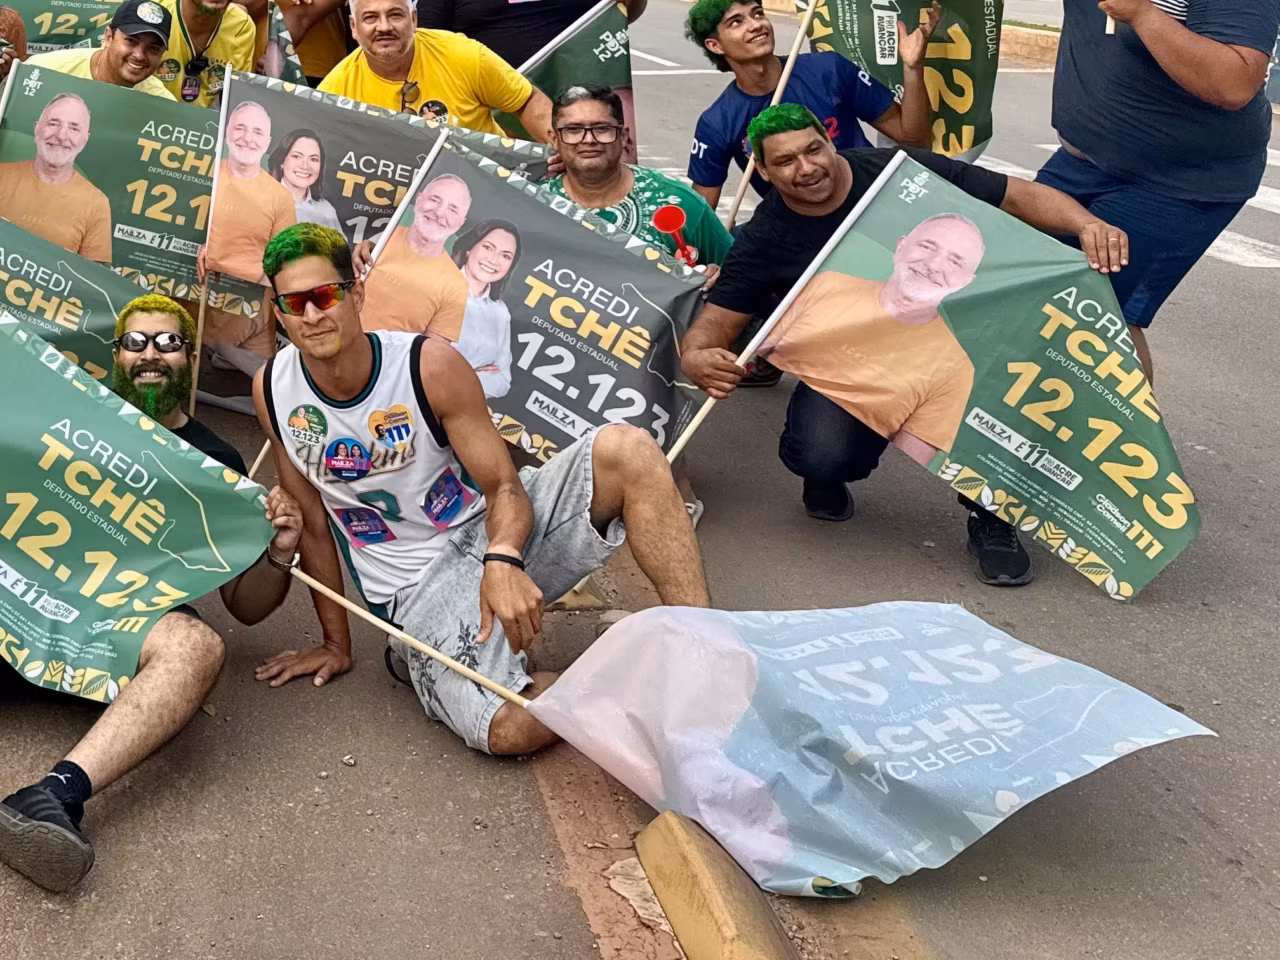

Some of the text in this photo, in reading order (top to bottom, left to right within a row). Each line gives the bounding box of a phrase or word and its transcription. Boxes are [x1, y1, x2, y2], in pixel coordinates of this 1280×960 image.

[51, 0, 82, 8] DEPUTADO
[877, 16, 886, 59] AVANÇAR
[984, 0, 998, 58] ESTADUAL
[593, 43, 611, 62] 12
[599, 31, 627, 57] PDT
[887, 30, 895, 59] ACRE
[23, 80, 43, 89] PDT
[24, 88, 36, 96] 12
[148, 166, 182, 180] DEPUTADO
[898, 189, 915, 204] 12
[900, 178, 929, 199] PDT
[354, 203, 394, 214] DEPUTADO
[117, 227, 174, 250] MAILZA 11
[182, 242, 198, 250] ACRE
[532, 258, 640, 322] ACREDI
[27, 315, 62, 335] ESTADUAL
[525, 275, 652, 370] TCHÊ
[531, 315, 619, 372] DEPUTADO ESTADUAL
[517, 331, 670, 446] 12.123
[1045, 347, 1136, 422] DEPUTADO ESTADUAL
[533, 397, 577, 429] MAILZA
[291, 429, 320, 443] 12.123
[385, 424, 410, 442] 111
[973, 412, 1013, 444] MAILZA
[1022, 443, 1048, 467] 11
[1001, 360, 1197, 531] 12.123
[50, 418, 158, 495] ACREDI
[1040, 464, 1073, 486] AVANÇAR
[1054, 463, 1078, 482] ACRE
[37, 433, 166, 545] TCHÊ
[43, 479, 128, 547] DEPUTADO ESTADUAL
[1095, 494, 1131, 528] Gladson
[1096, 504, 1127, 532] Cameli
[0, 492, 190, 612] 12.123
[1125, 519, 1164, 560] 111
[20, 580, 46, 607] 11
